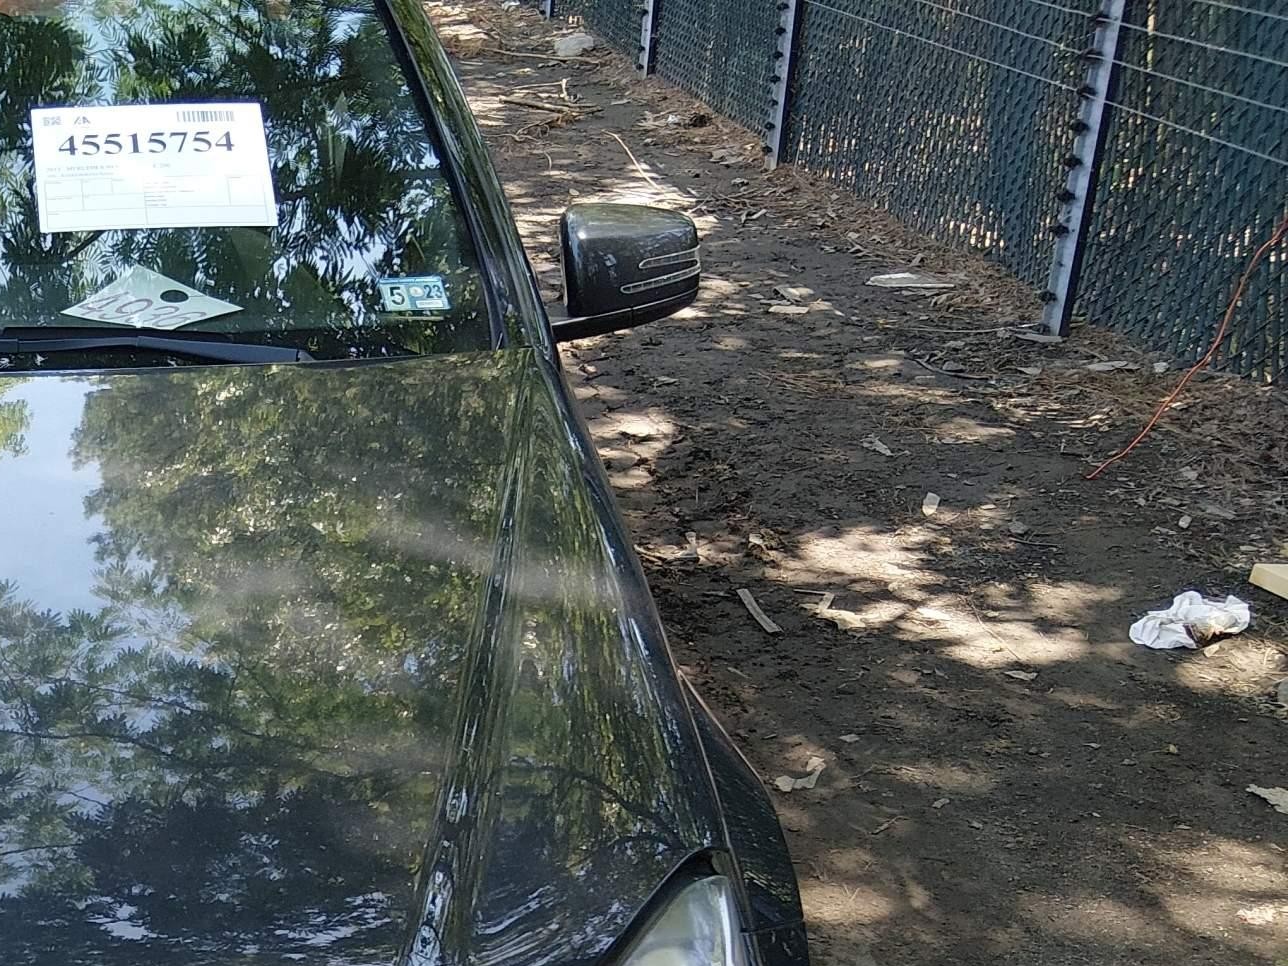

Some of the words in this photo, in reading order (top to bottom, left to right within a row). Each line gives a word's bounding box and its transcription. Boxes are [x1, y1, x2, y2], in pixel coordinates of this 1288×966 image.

[58, 130, 235, 156] 45515754
[389, 286, 405, 306] 5
[423, 284, 443, 298] 23
